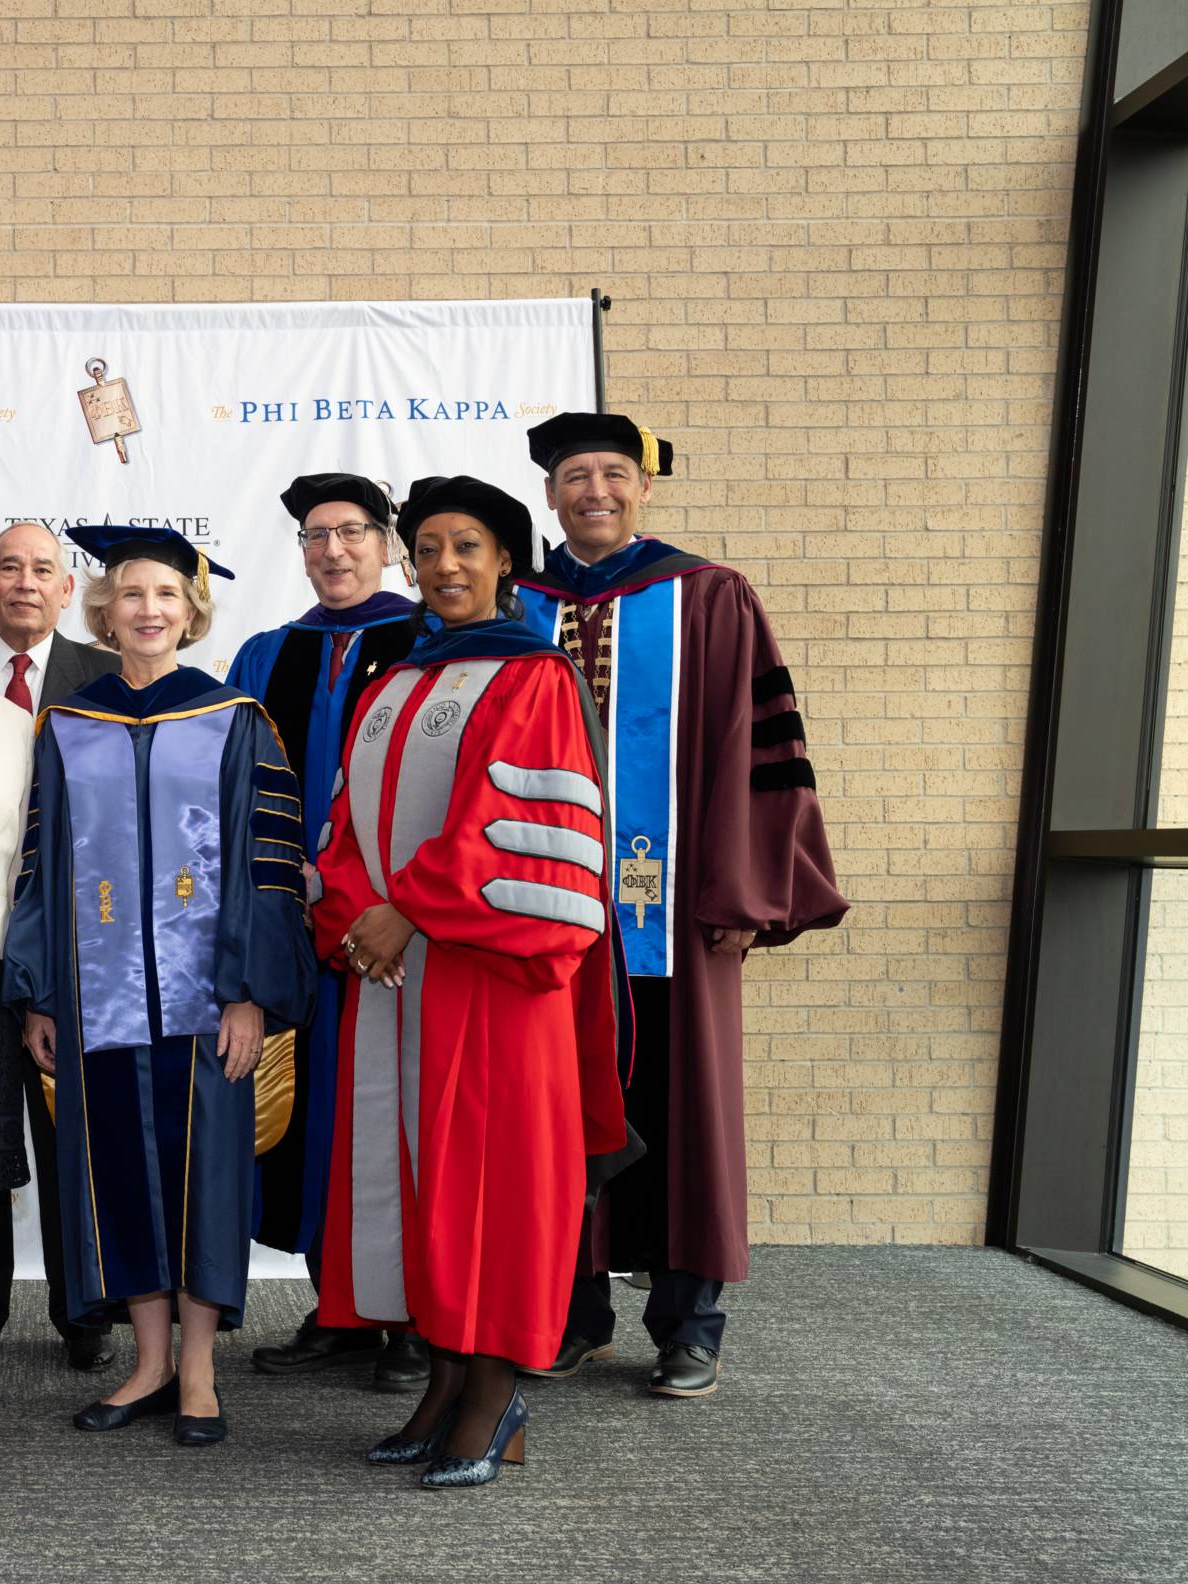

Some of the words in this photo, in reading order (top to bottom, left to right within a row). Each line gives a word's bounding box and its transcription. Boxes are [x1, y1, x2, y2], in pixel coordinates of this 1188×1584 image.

[212, 406, 233, 419] The
[240, 401, 300, 423] PHI
[313, 398, 396, 420] BETA
[407, 398, 511, 420] KAPPA
[515, 401, 558, 418] Society
